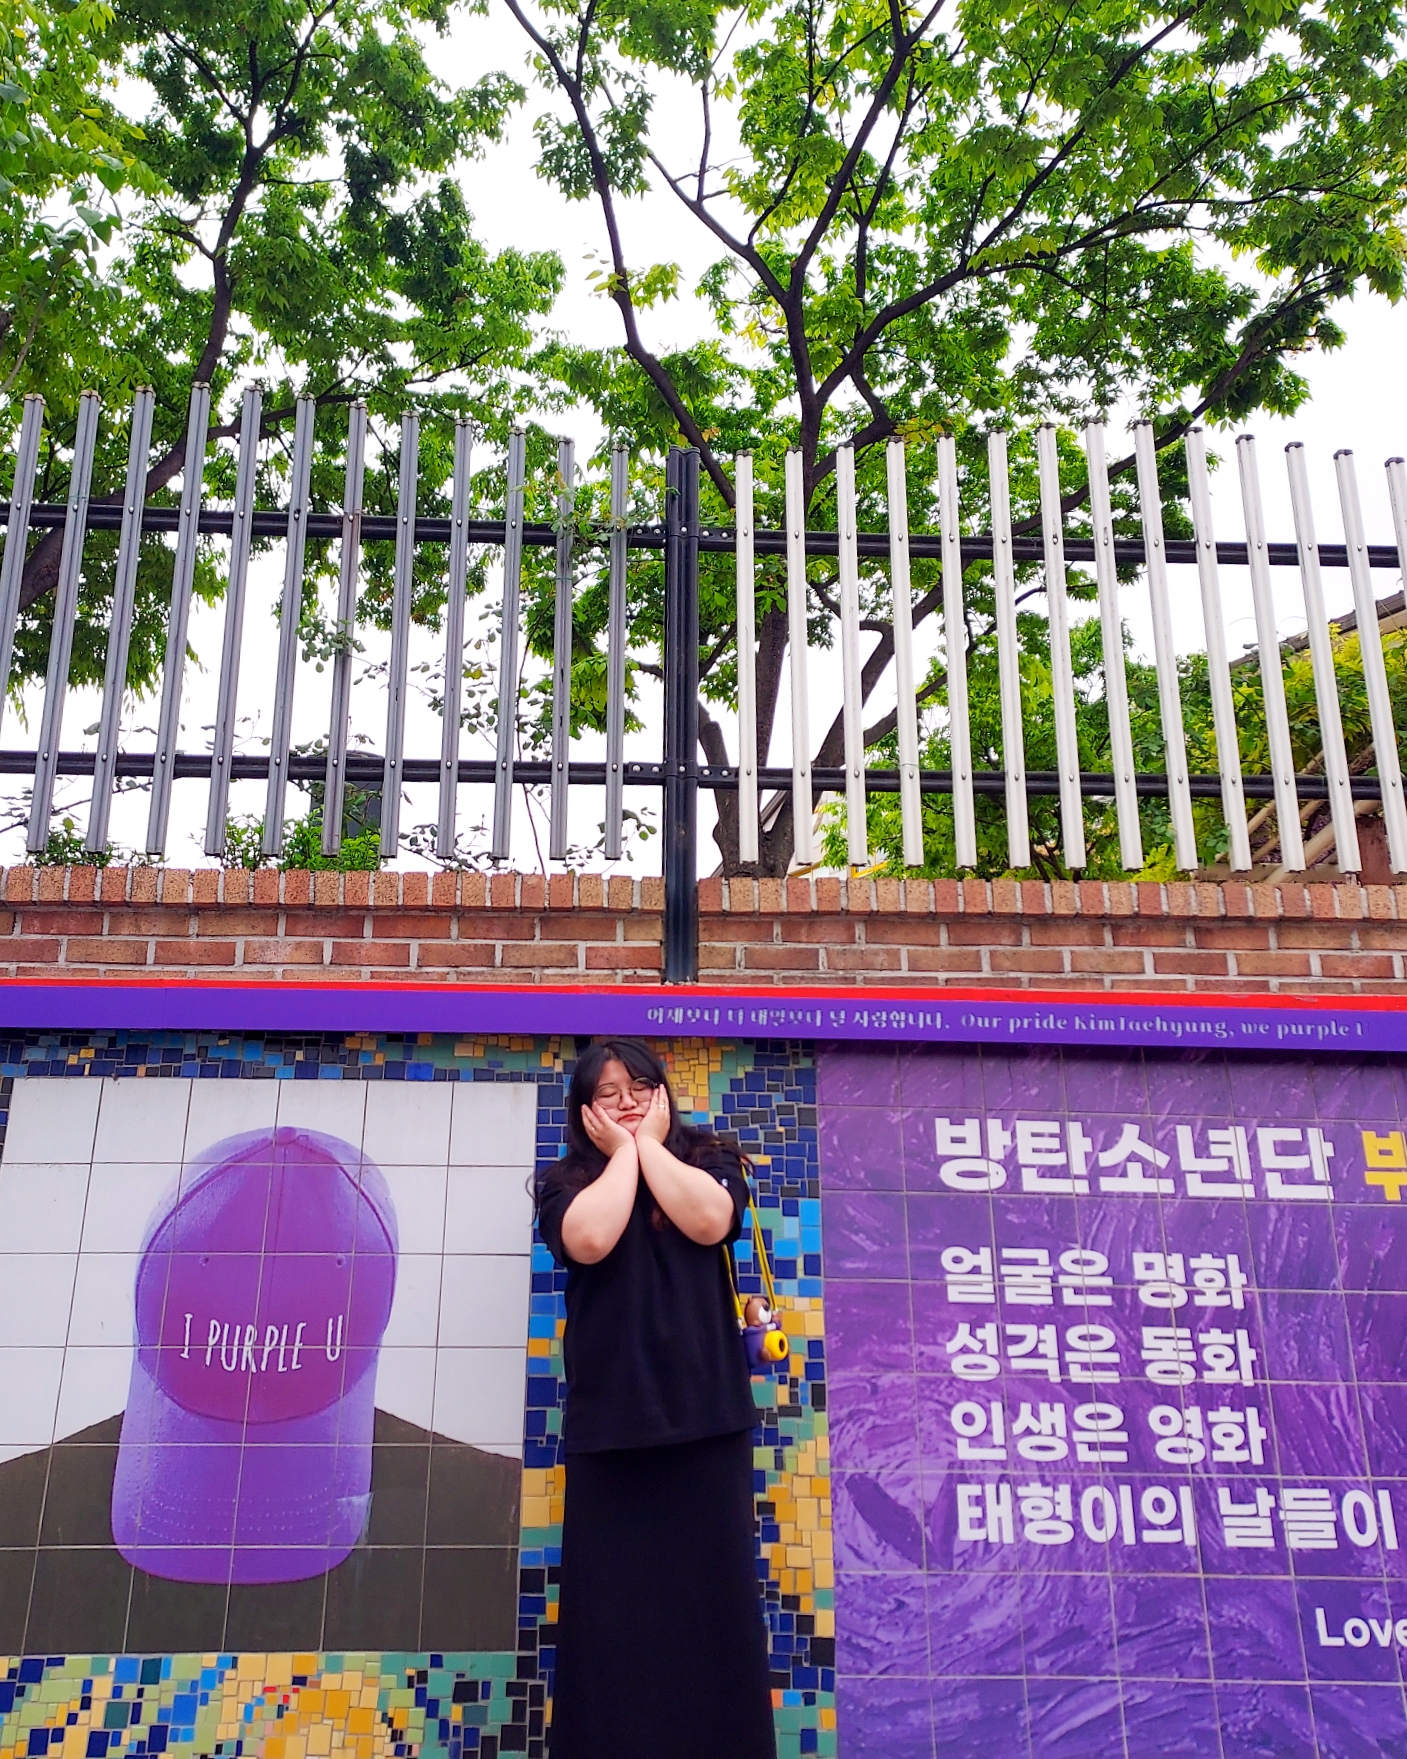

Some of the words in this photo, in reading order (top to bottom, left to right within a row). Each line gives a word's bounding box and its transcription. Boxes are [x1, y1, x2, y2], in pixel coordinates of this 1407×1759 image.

[647, 1006, 719, 1025] 어제보다
[727, 1008, 744, 1026] 더
[750, 1008, 822, 1028] 내일보다
[852, 1009, 951, 1030] 사랑합니다.
[961, 1012, 1002, 1029] Our
[1008, 1012, 1067, 1033] pride
[1240, 1021, 1270, 1035] we
[1276, 1021, 1350, 1041] purple
[934, 1117, 1335, 1200] 방탄소년단
[940, 1246, 1113, 1307] 얼굴은
[1132, 1251, 1248, 1310] 명화
[180, 1312, 193, 1359] I
[205, 1319, 307, 1373] PURPLE
[326, 1314, 344, 1362] U
[946, 1322, 1120, 1384] 성격은
[1141, 1326, 1257, 1387] 동화
[950, 1401, 1129, 1463] 인생은
[1148, 1405, 1267, 1466] 영화
[956, 1482, 1197, 1546] 태형이의
[1218, 1486, 1399, 1550] 날들이
